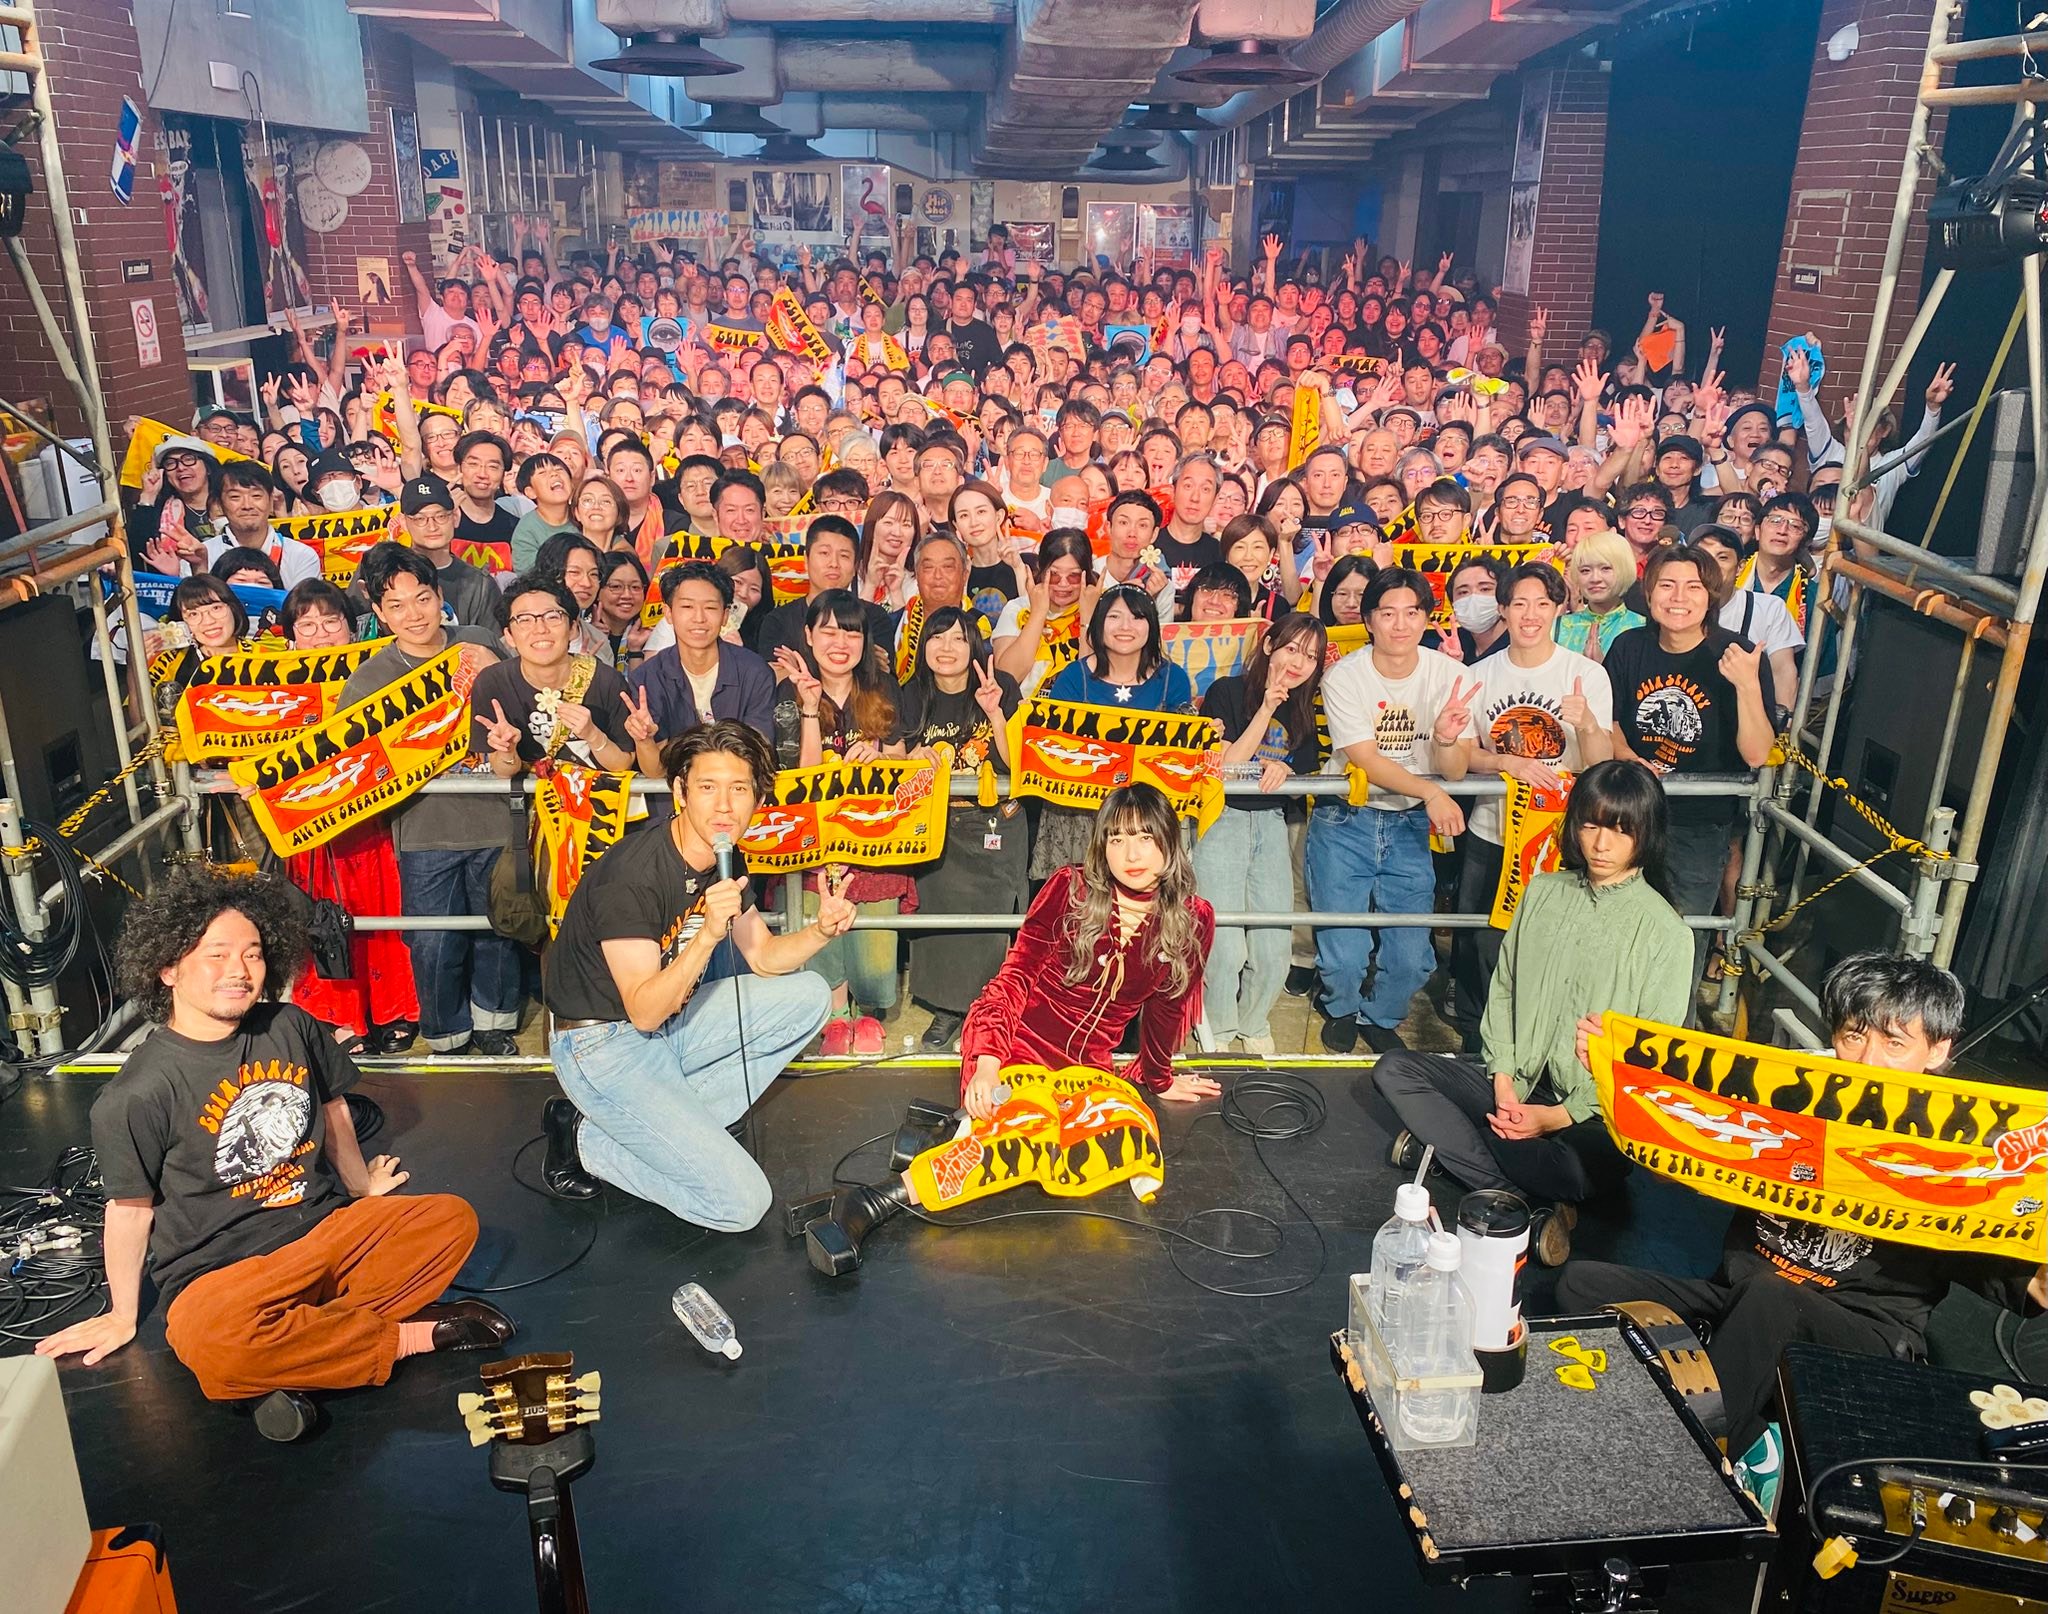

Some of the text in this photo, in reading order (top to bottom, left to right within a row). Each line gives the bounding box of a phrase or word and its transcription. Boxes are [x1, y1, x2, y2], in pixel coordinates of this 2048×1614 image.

[925, 201, 948, 215] Shot
[928, 194, 946, 206] Hip
[255, 728, 342, 790] GLIM
[344, 660, 453, 748] SPANKY
[1026, 700, 1100, 740] GLIM
[785, 767, 903, 805] SPANKY
[1045, 780, 1065, 795] THE
[293, 827, 314, 846] ALL
[312, 811, 337, 835] THE
[339, 778, 402, 819] GREATEST
[757, 849, 821, 867] GREATEST
[862, 842, 892, 857] TOUR
[895, 840, 927, 854] 2025
[198, 1059, 308, 1134] GLIM PANKY
[1624, 1028, 2020, 1148] GLIM SPANKY
[1626, 1141, 1660, 1169] ALL
[1667, 1154, 1705, 1177] THE
[1714, 1168, 1825, 1214] GREATEST
[1831, 1199, 1910, 1230] DUDES
[1971, 1218, 2036, 1240] 2025
